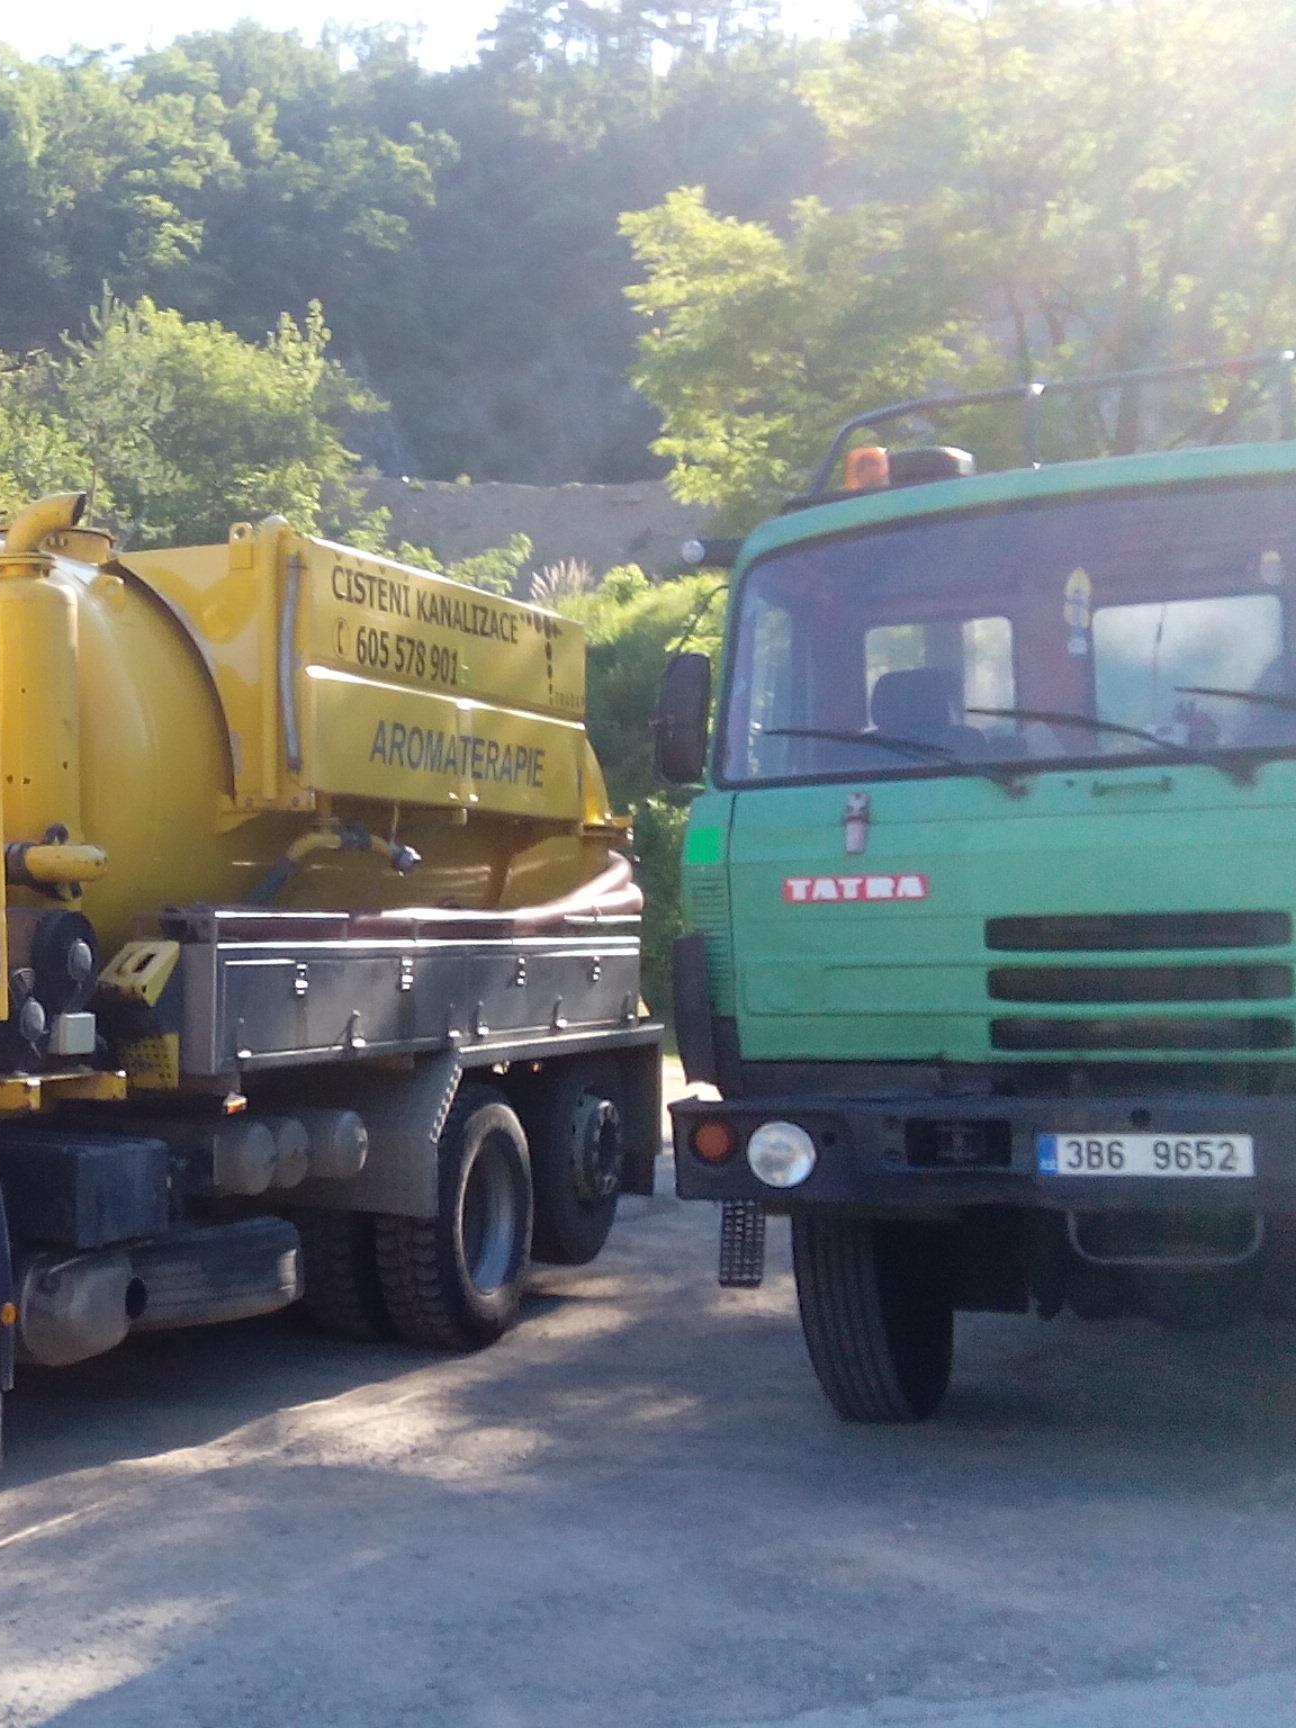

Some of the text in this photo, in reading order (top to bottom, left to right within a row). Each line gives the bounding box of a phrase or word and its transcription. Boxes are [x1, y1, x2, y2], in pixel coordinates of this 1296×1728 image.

[416, 588, 519, 645] KANALIZACE
[356, 625, 459, 686] 605 578 901
[369, 719, 546, 788] AROMATERAPIE
[786, 875, 925, 901] TATRA
[1066, 1140, 1125, 1170] 3B6
[1153, 1140, 1237, 1171] 9652
